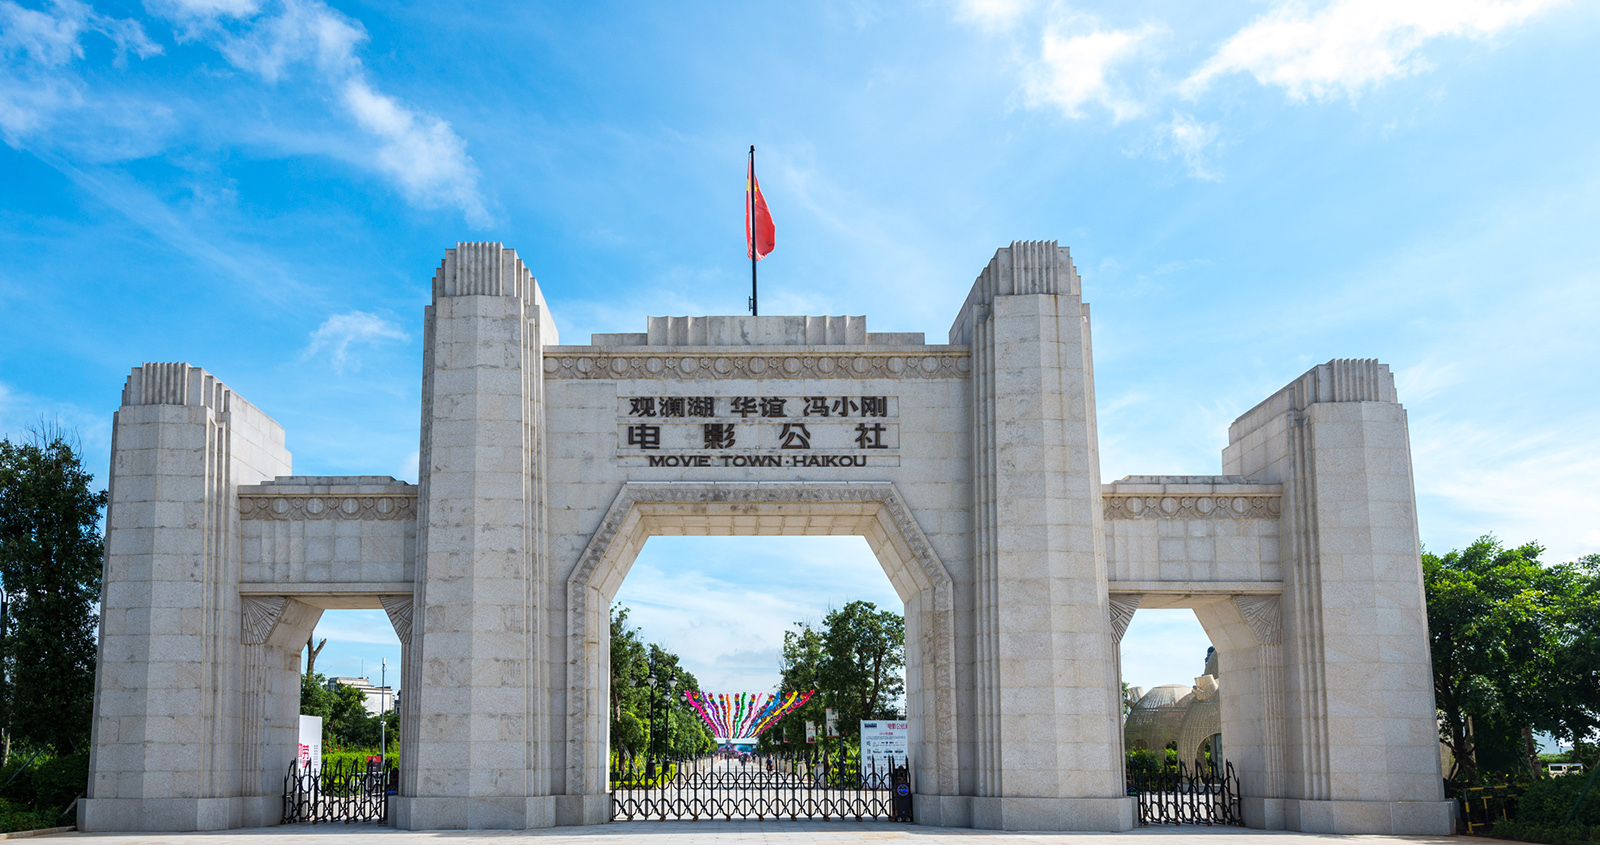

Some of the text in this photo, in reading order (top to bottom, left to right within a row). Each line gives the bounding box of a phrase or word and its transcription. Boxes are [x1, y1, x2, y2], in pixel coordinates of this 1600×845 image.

[629, 396, 888, 418] 观澜湖 华谊 冯小刚
[628, 423, 888, 449] 电影公社
[649, 455, 711, 467] MOVIE
